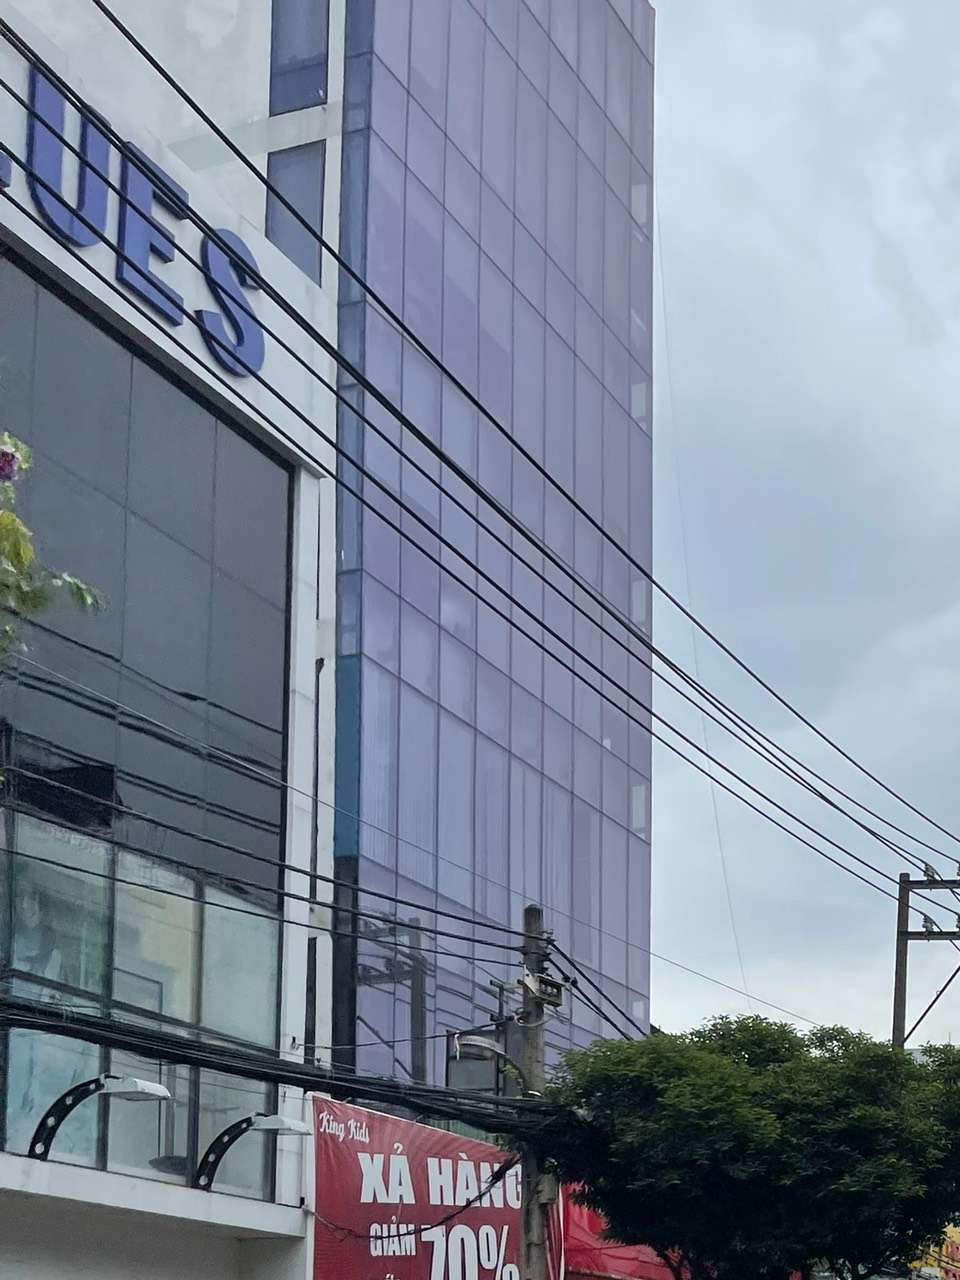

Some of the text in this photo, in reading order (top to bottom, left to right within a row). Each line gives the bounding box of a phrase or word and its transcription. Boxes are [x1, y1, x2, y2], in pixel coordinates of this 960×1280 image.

[0, 65, 266, 379] UES
[319, 1111, 370, 1143] King Kids
[357, 1143, 522, 1209] XẢ HÀNG
[369, 1216, 416, 1257] GIẢM
